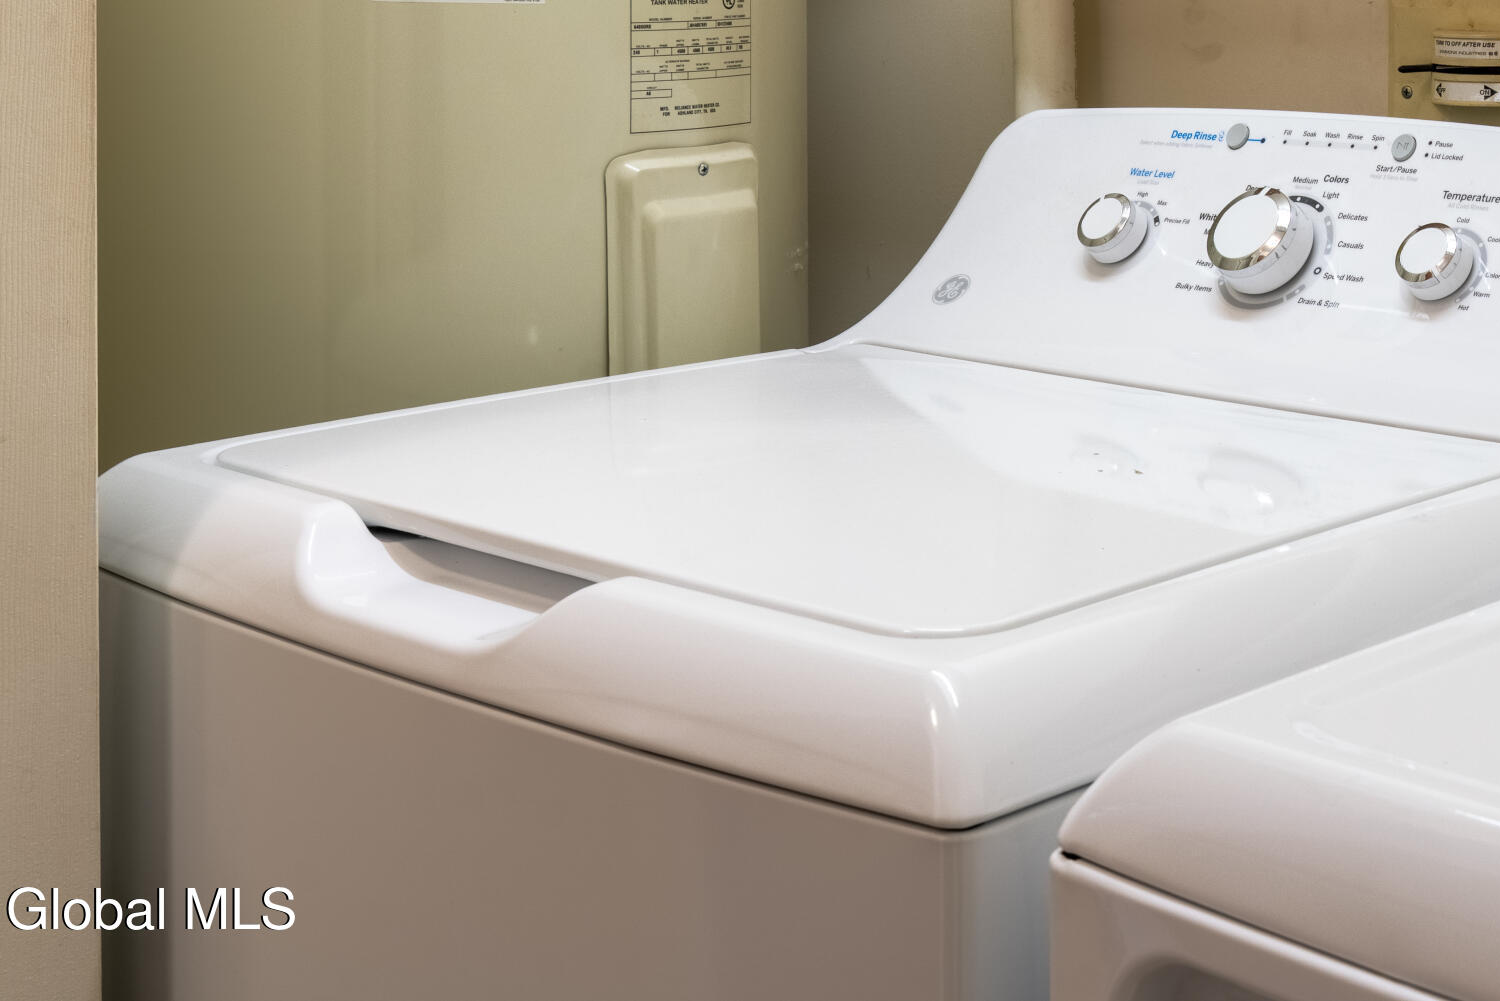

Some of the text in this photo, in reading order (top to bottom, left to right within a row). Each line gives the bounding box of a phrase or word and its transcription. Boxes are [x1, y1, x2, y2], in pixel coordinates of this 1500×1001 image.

[1171, 130, 1217, 141] Deep Rinse
[1130, 168, 1176, 178] Water Level
[1376, 165, 1417, 174] Start/Pause
[1292, 175, 1349, 184] Medium Colors
[1322, 191, 1340, 200] Light
[1443, 190, 1500, 203] Temperature
[1200, 213, 1217, 221] Whit
[1338, 213, 1368, 222] Delicates
[1337, 241, 1364, 250] Casuals
[1196, 260, 1214, 268] Heavy
[1346, 274, 1364, 282] Wash
[1175, 283, 1212, 293] Bulky Items
